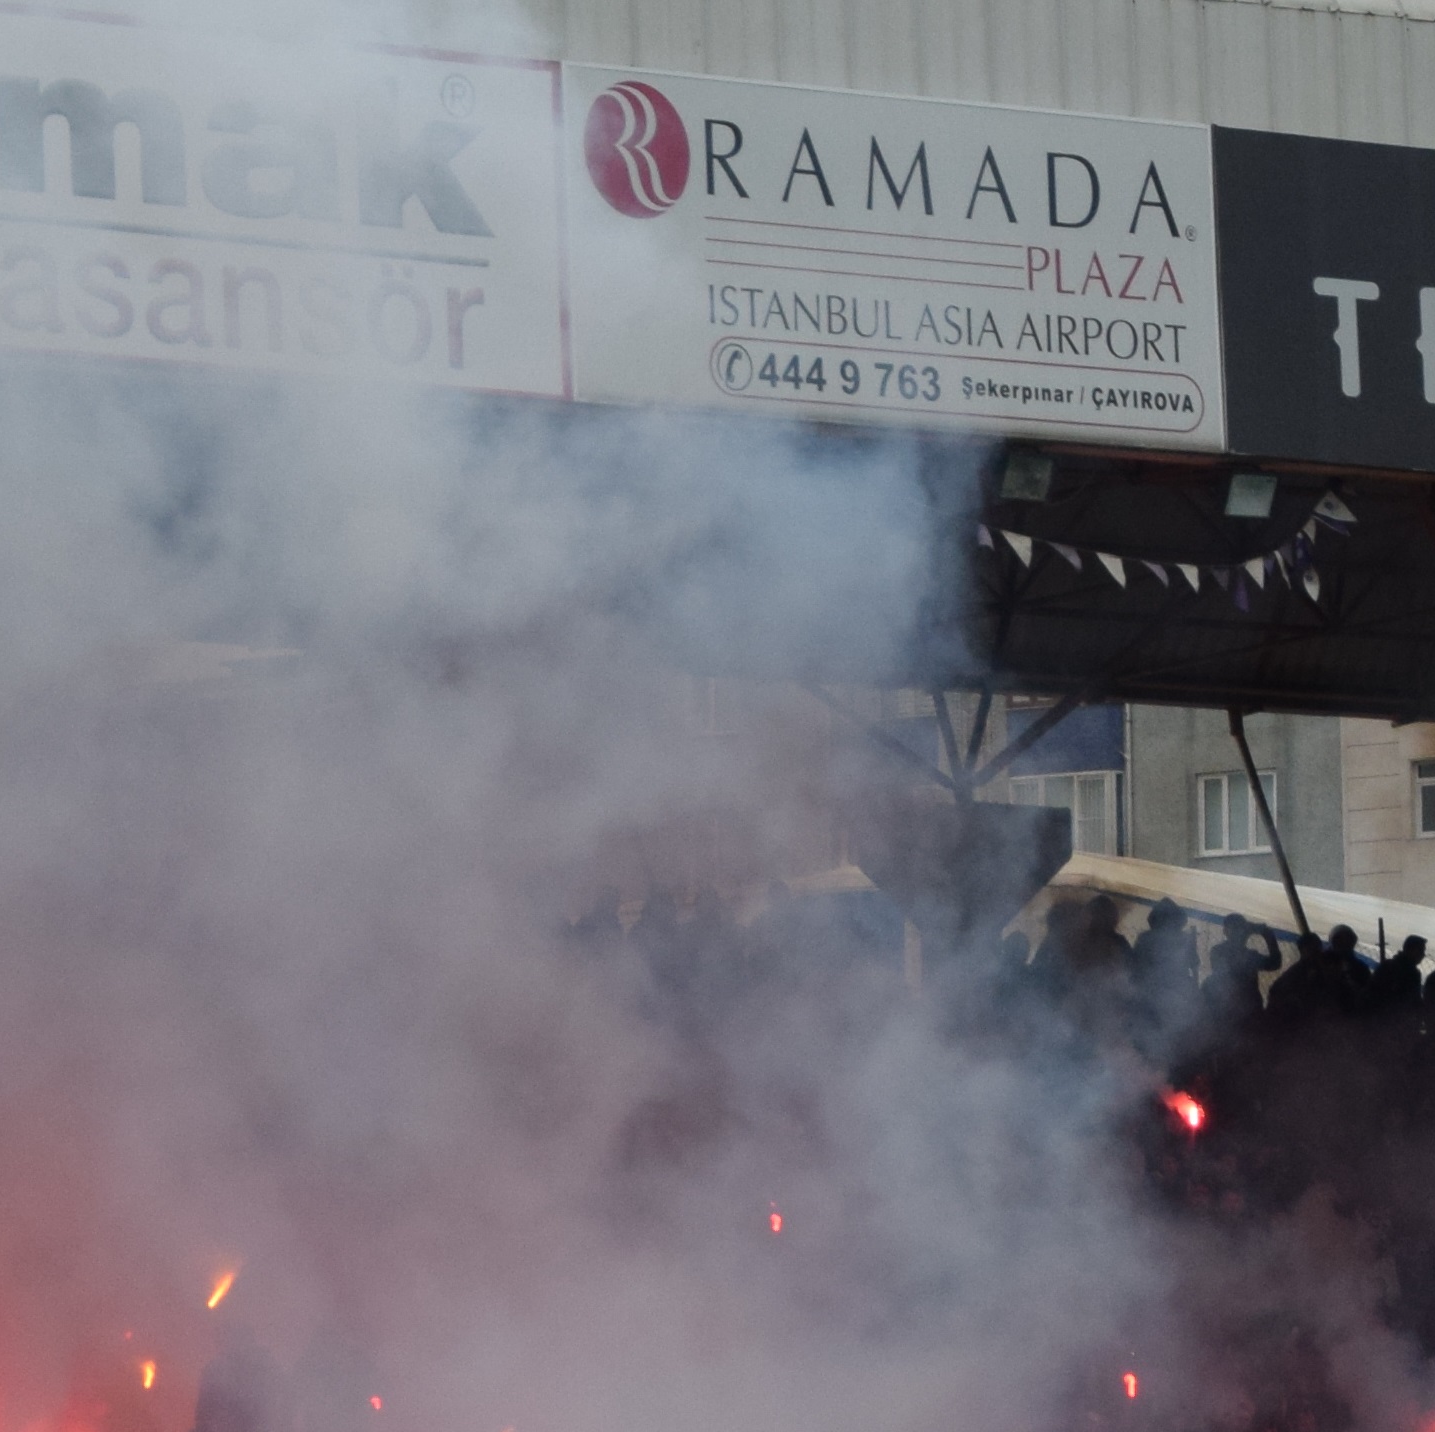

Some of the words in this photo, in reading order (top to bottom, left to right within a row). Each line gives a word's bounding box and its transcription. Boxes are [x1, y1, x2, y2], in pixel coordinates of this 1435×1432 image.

[703, 117, 1182, 239] RAMADA
[1025, 245, 1185, 304] PLAZA
[706, 283, 902, 341] ISTANBUL
[914, 304, 1003, 349] ASIA
[1016, 310, 1187, 364] AIRPORT
[758, 352, 828, 393] 444
[840, 357, 861, 394] 9
[875, 363, 942, 402] 763
[961, 376, 1074, 406] Şekerpınar
[1091, 385, 1196, 414] ÇAYIROVA
